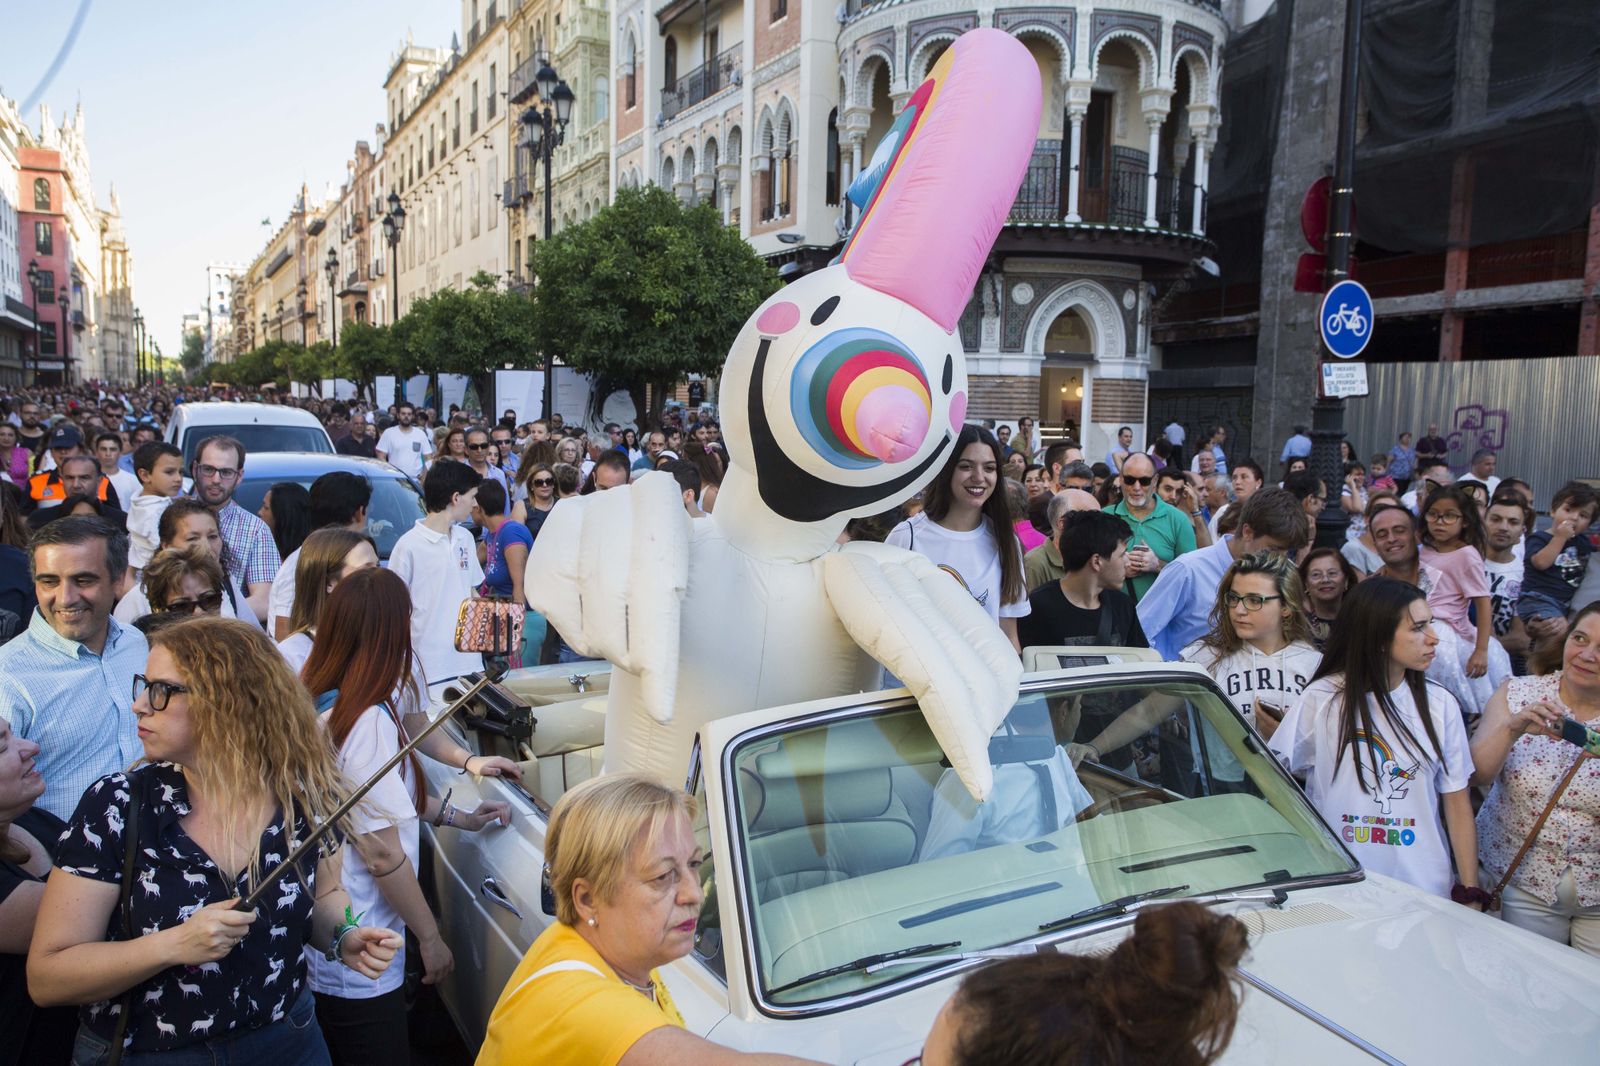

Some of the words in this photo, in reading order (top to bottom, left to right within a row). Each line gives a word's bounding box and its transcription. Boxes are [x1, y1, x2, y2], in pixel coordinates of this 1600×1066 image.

[1227, 667, 1307, 697] GIRLS
[1362, 815, 1401, 827] CUMPLE
[1403, 818, 1416, 827] DE
[1342, 825, 1416, 846] CURRO
